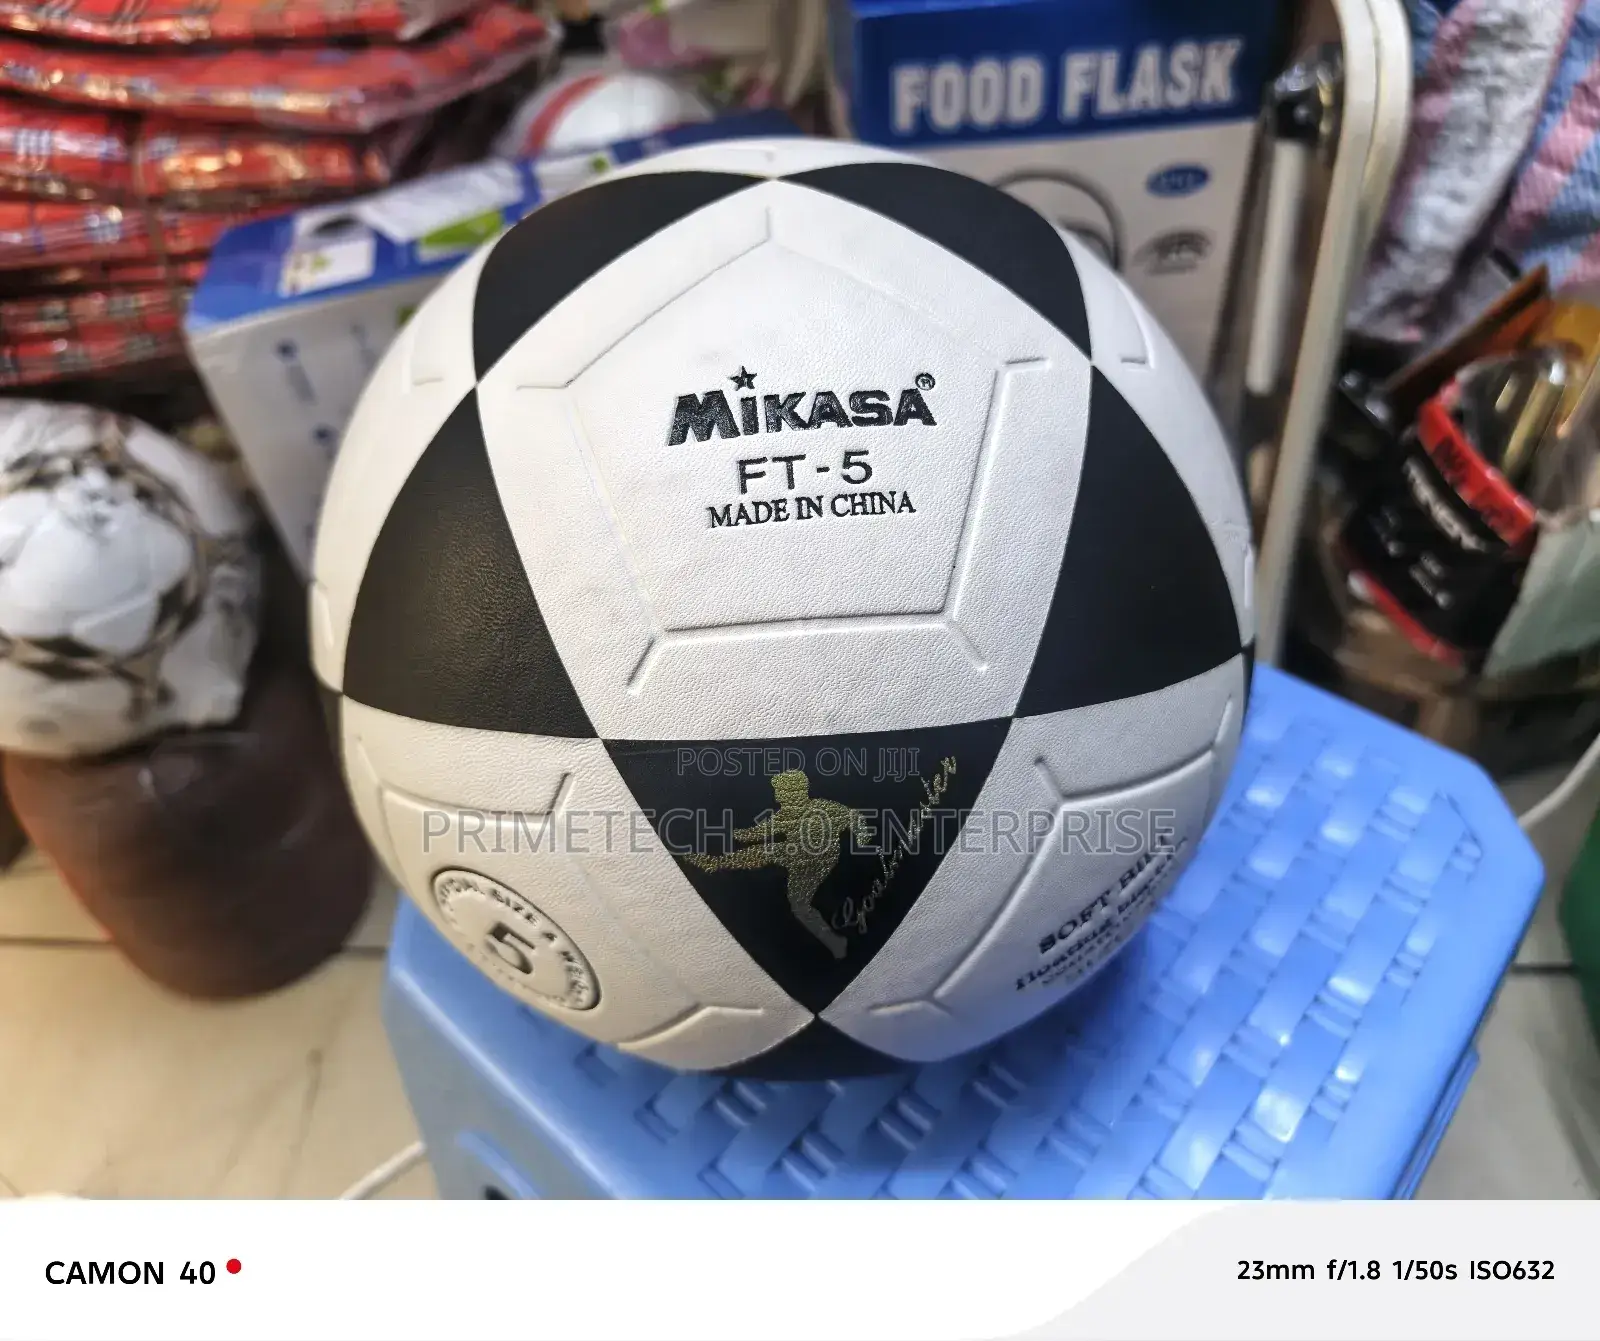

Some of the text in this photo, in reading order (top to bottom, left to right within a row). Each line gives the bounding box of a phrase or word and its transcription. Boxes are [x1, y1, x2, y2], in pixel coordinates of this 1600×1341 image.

[891, 36, 1242, 135] FOOD FLASK
[707, 490, 916, 529] MADE IN CHINA
[484, 921, 536, 976] 5
[1039, 889, 1112, 954] SOFT
